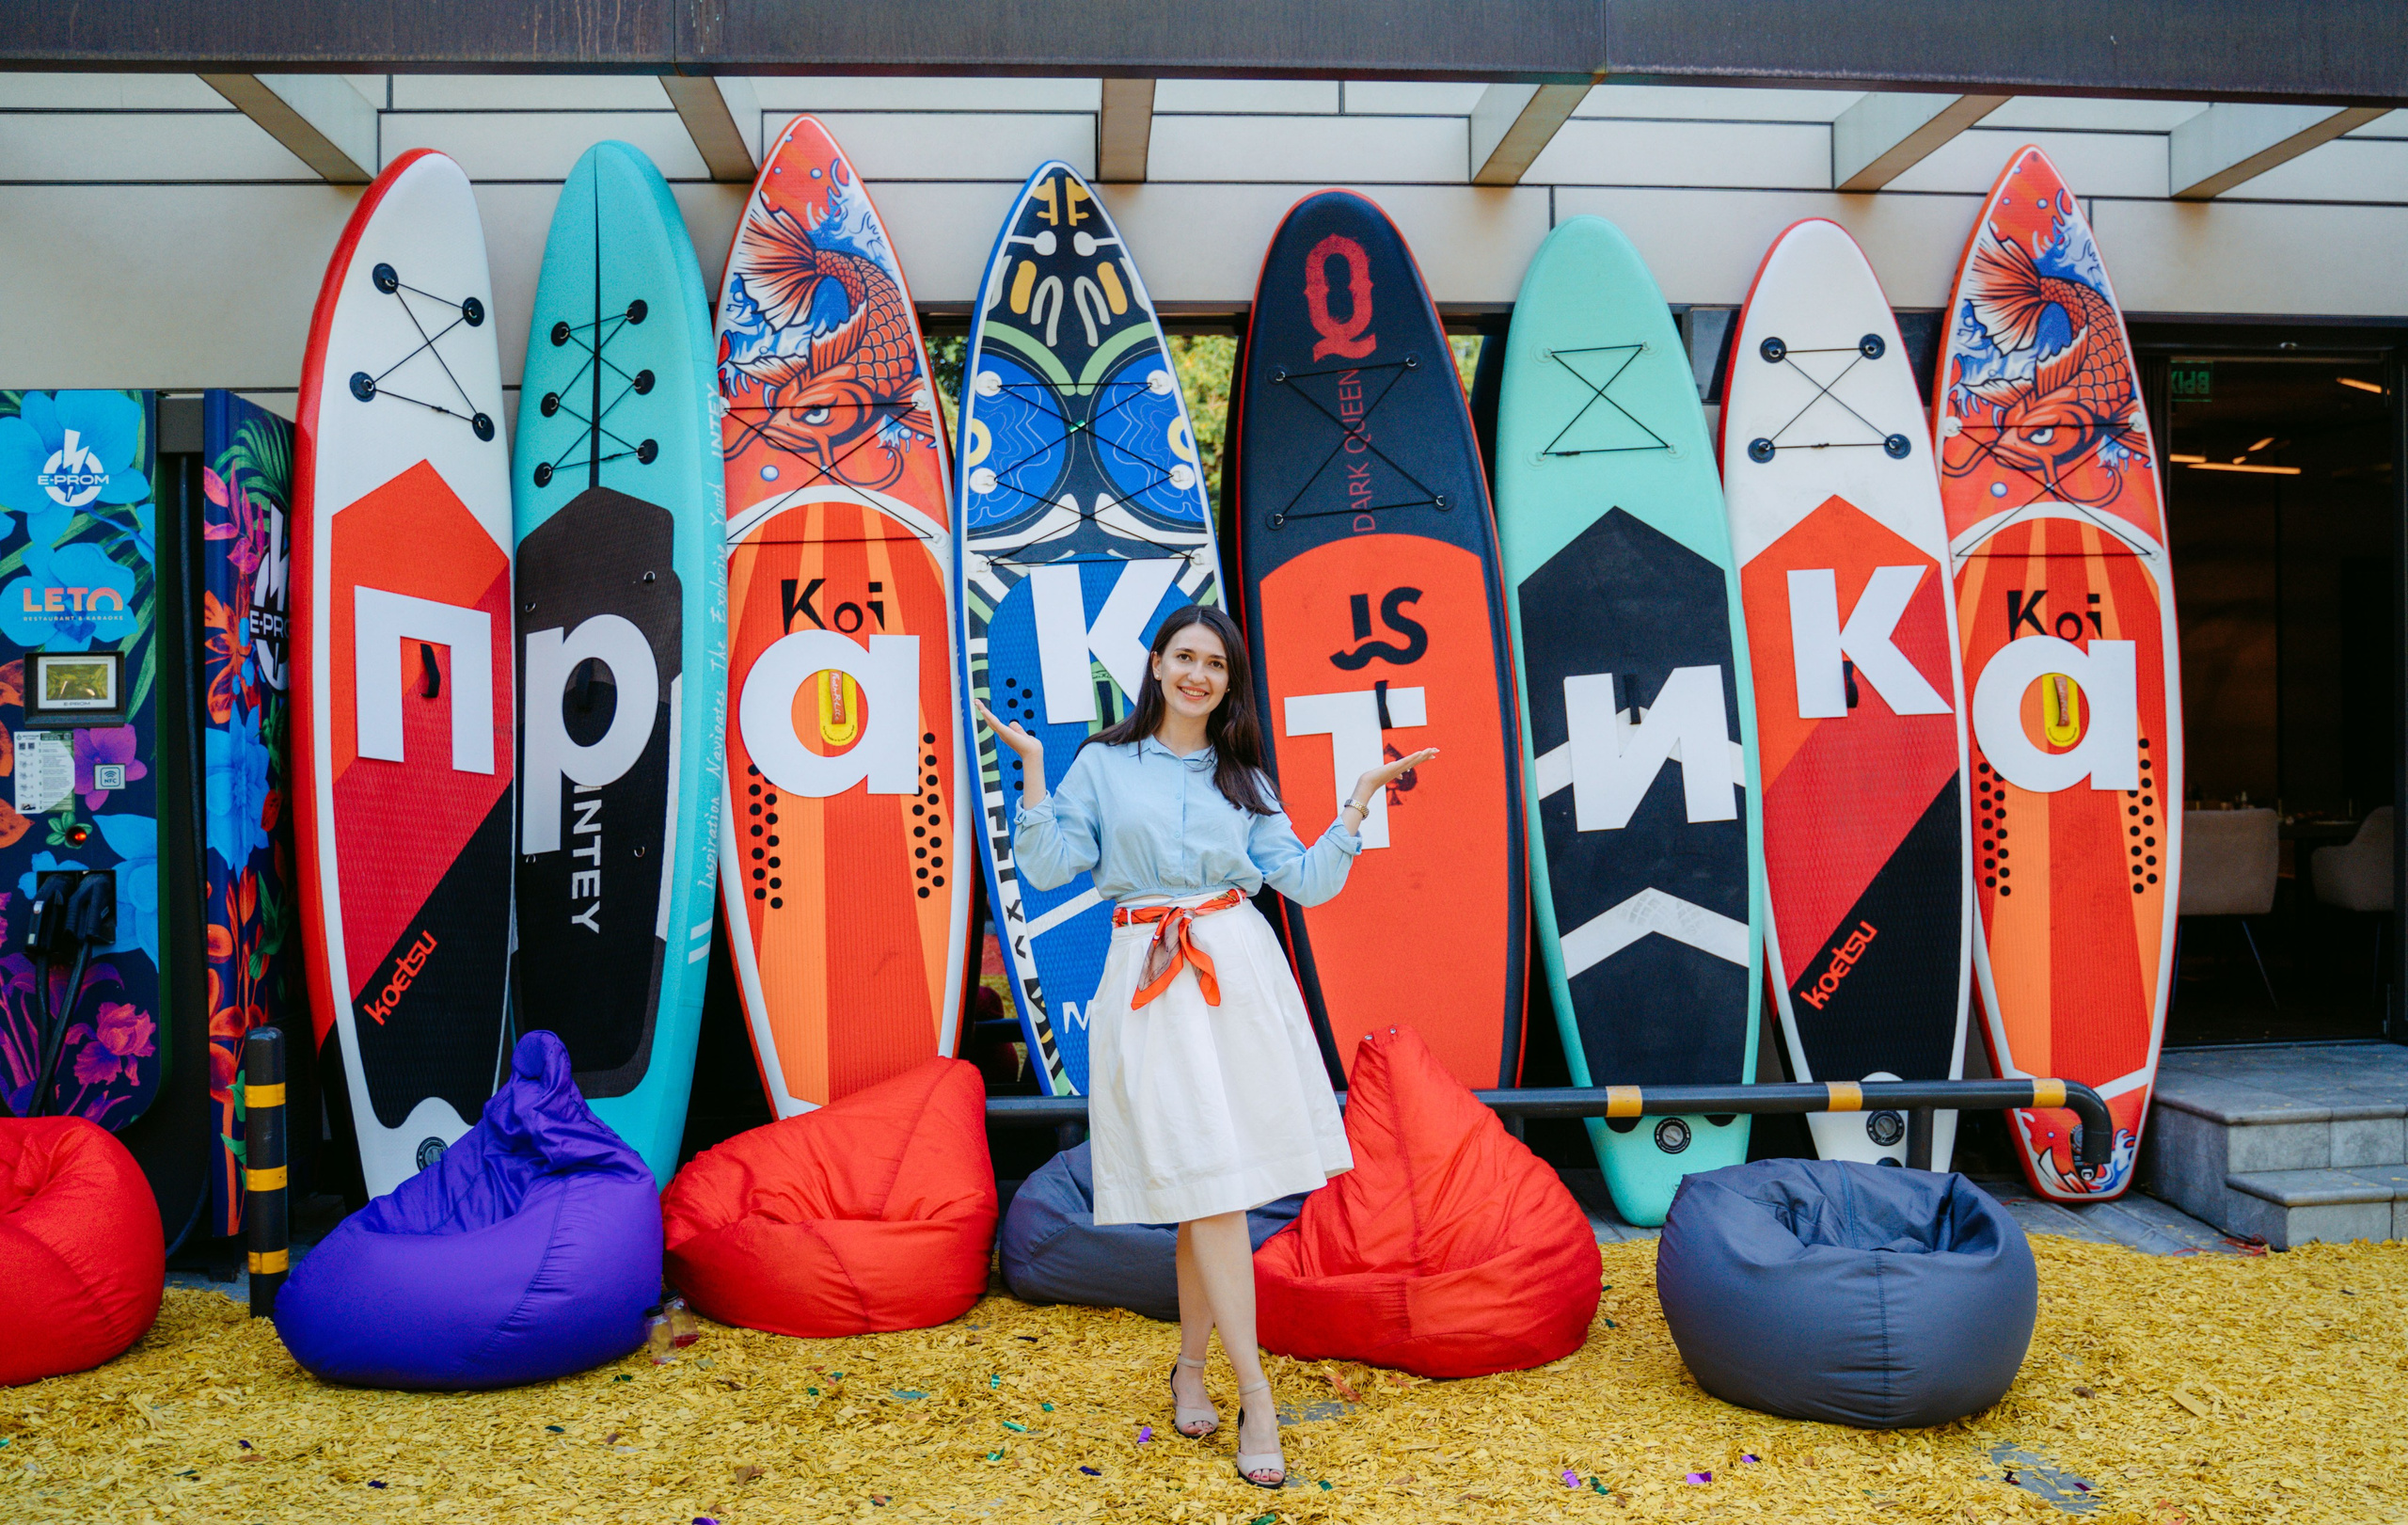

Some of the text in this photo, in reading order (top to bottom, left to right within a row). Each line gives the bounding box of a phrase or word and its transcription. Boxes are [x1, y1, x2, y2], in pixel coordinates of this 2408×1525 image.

[1304, 232, 1376, 363] Q
[706, 383, 724, 459] INTEY
[1337, 368, 1376, 532] DARK QUEEN
[38, 474, 109, 485] E-PROM
[24, 587, 123, 612] LETO
[781, 578, 885, 635] Koi
[2006, 590, 2102, 642] Koi
[707, 641, 726, 673] The
[706, 690, 725, 780] Navigates
[571, 786, 603, 934] INTEY
[697, 796, 721, 890] Inspiration
[363, 929, 438, 1026] koetsu
[1799, 920, 1877, 1010] koetsu
